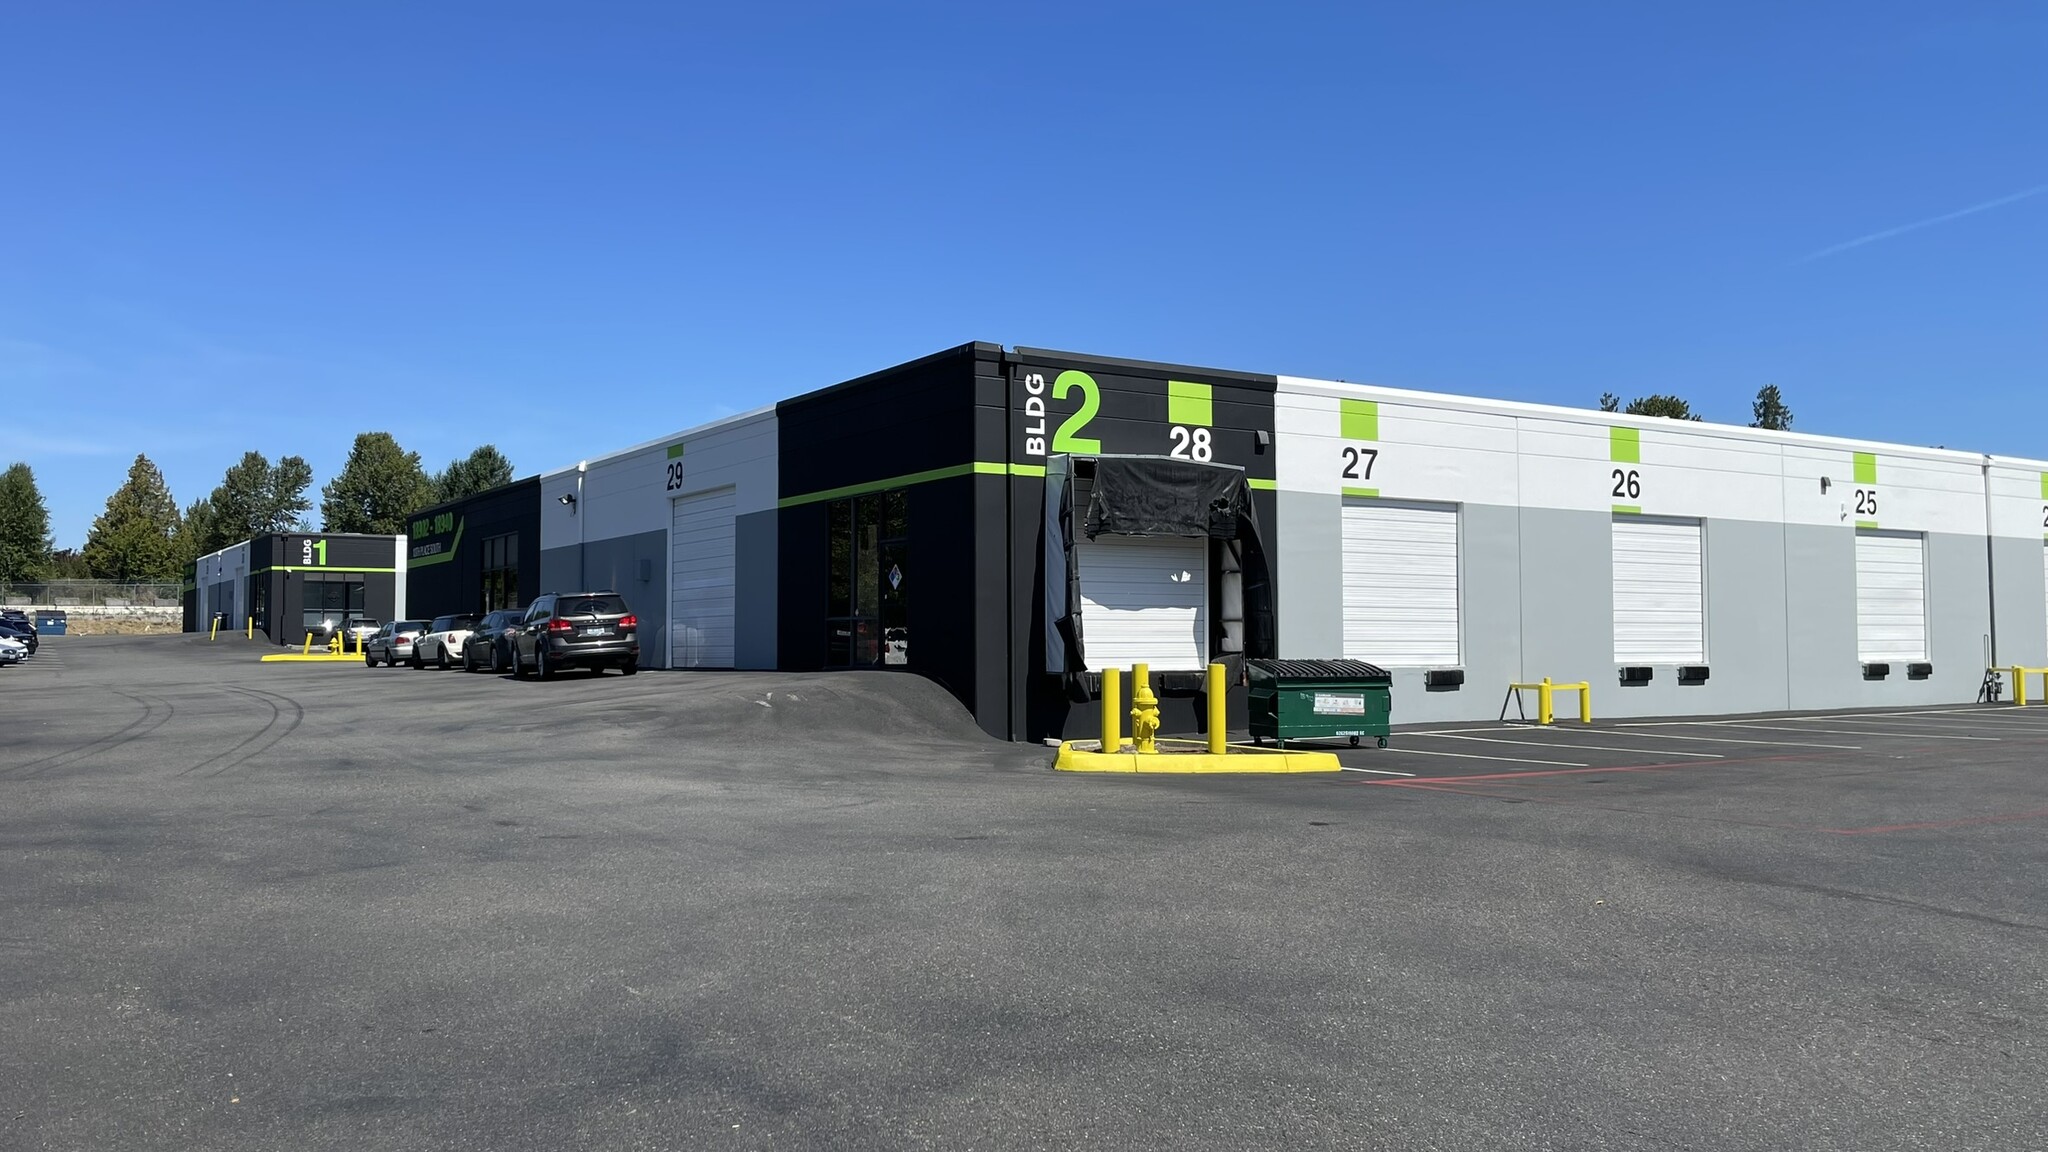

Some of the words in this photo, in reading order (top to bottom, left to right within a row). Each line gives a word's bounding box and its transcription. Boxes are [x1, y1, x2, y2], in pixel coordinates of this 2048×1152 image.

[1025, 374, 1045, 455] BLDG
[1052, 370, 1100, 454] 2
[1169, 426, 1212, 462] 28
[667, 461, 683, 491] 29
[1342, 446, 1378, 480] 27
[1612, 468, 1640, 499] 26
[1855, 489, 1877, 515] 25
[303, 539, 312, 565] BLDG
[313, 539, 327, 566] 1
